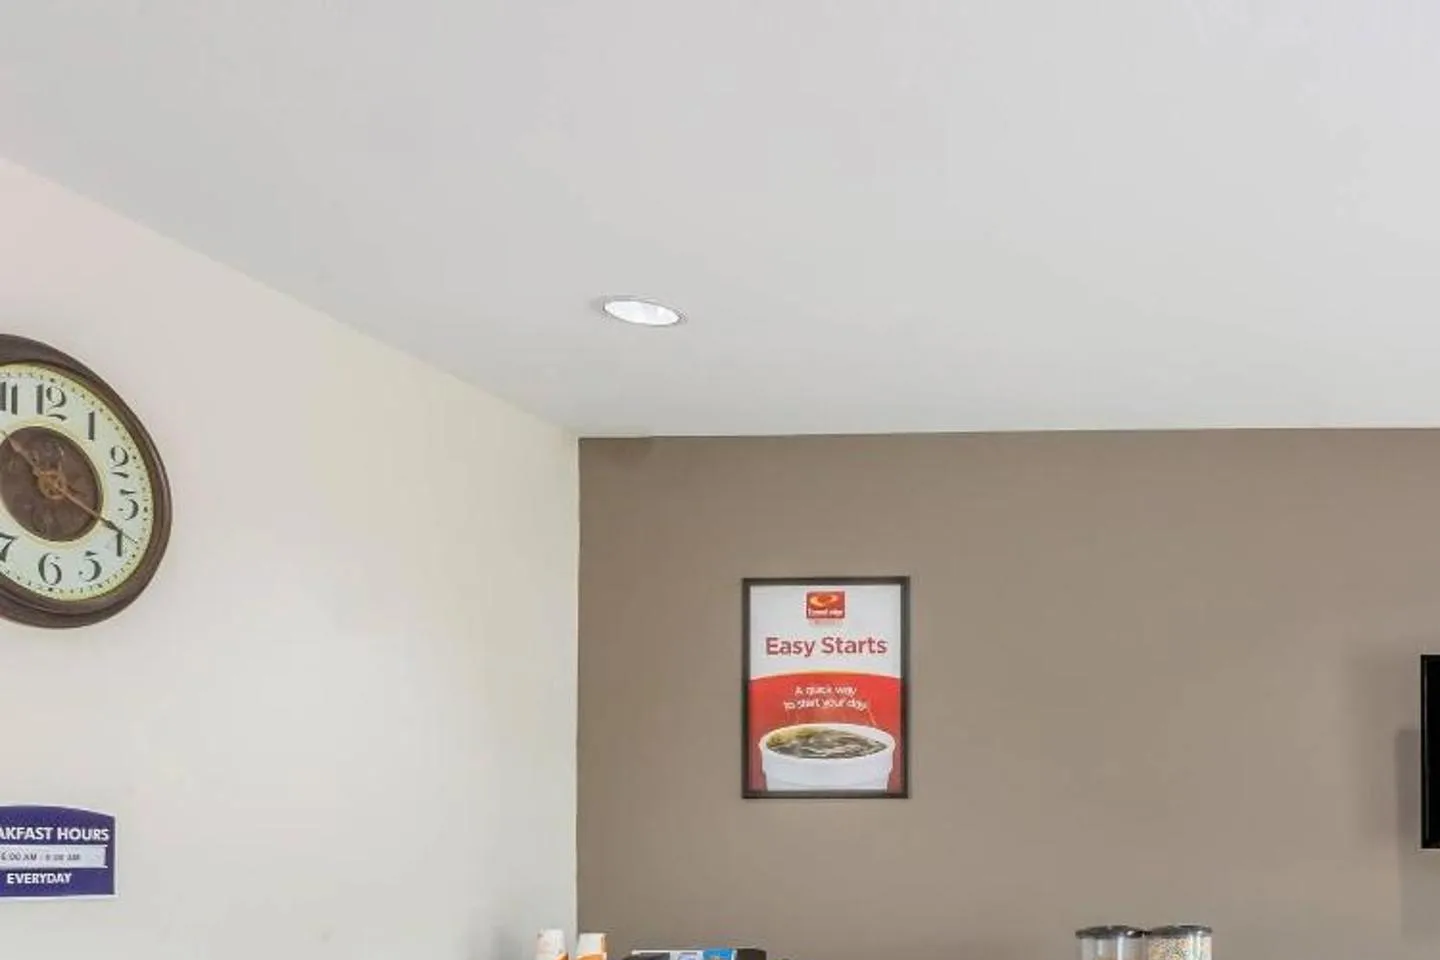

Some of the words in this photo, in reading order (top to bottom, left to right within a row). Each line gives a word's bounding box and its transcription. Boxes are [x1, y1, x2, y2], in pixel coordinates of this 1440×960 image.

[36, 383, 67, 421] 12
[88, 410, 96, 441] 1
[110, 445, 129, 479] 2
[38, 553, 62, 585] 6
[78, 551, 102, 582] 5
[766, 637, 815, 657] Easy
[821, 636, 888, 654] Starts
[56, 828, 111, 841] HOURS
[6, 872, 72, 884] EVERYDAY
